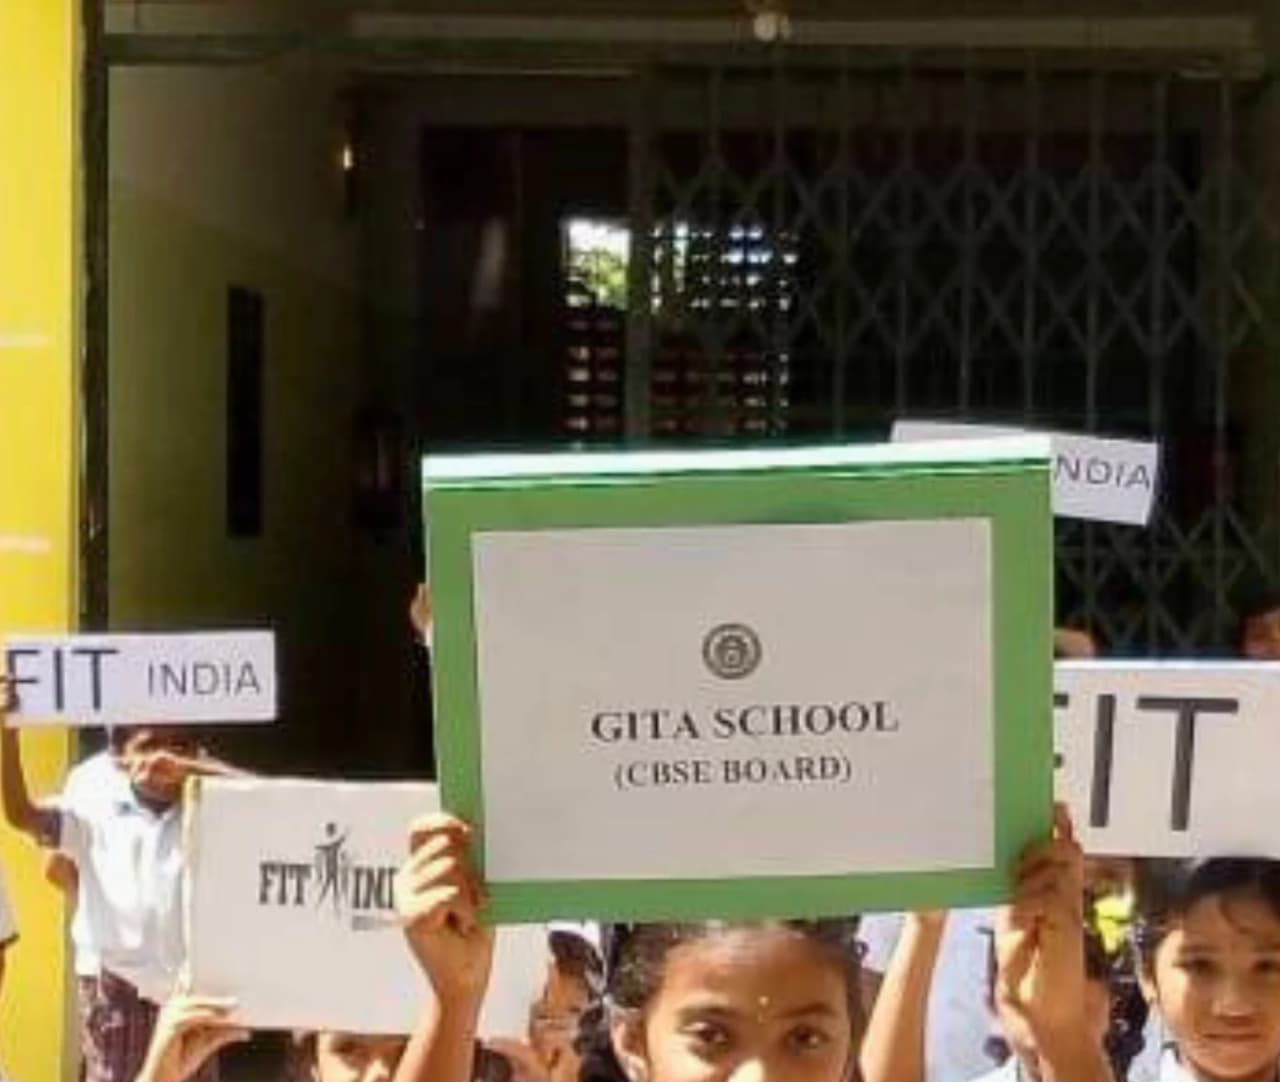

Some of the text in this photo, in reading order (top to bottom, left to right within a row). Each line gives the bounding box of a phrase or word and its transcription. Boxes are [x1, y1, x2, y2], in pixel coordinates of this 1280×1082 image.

[1054, 454, 1152, 489] NDIA
[5, 648, 261, 712] FIT INDIA
[591, 701, 900, 743] GITA SCHOOL
[613, 755, 852, 790] (CBSE BOARD)
[258, 862, 312, 906] FIT
